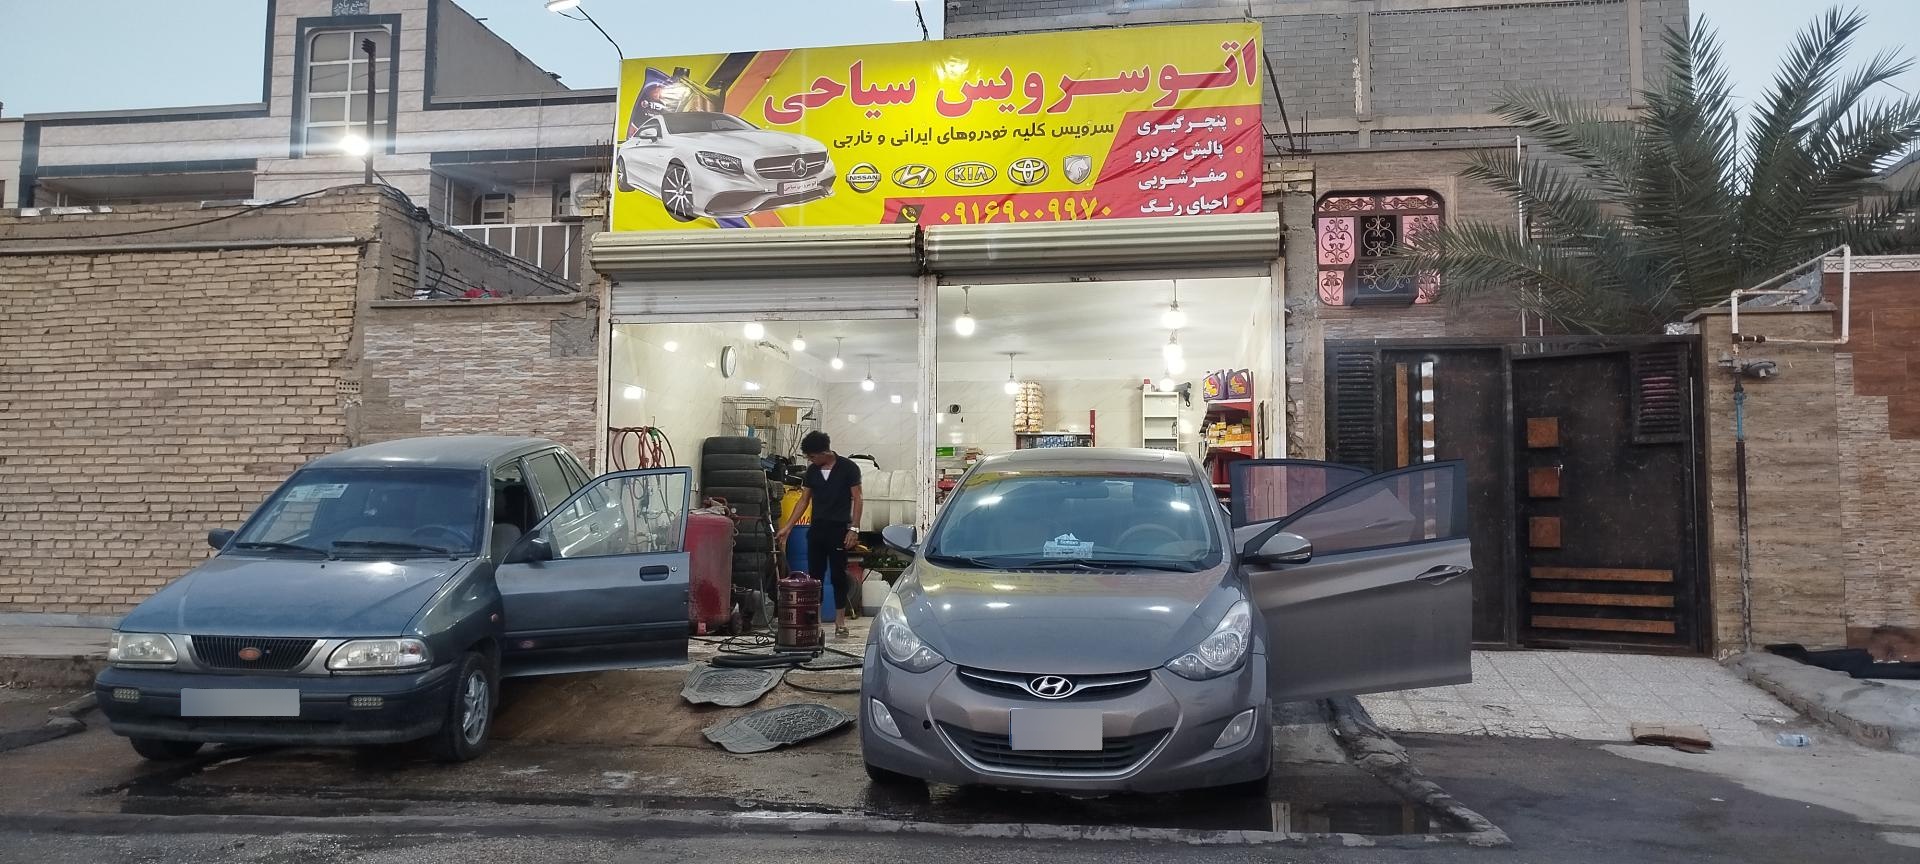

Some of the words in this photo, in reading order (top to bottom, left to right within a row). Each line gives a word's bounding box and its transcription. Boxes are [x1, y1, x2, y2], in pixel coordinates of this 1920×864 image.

[763, 58, 917, 125] سیاحی
[833, 129, 873, 149] خارجی
[877, 133, 886, 145] و
[890, 128, 932, 147] ایرانی
[937, 128, 1008, 144] خودروهای
[1012, 122, 1046, 141] کلیه
[1051, 123, 1114, 137] سرویس
[1134, 142, 1179, 163] خودرو
[1183, 140, 1224, 160] پالیش
[849, 174, 879, 182] NISSAN
[953, 166, 989, 182] KIA
[1140, 197, 1182, 216] رنگ
[1186, 194, 1228, 215] احیای
